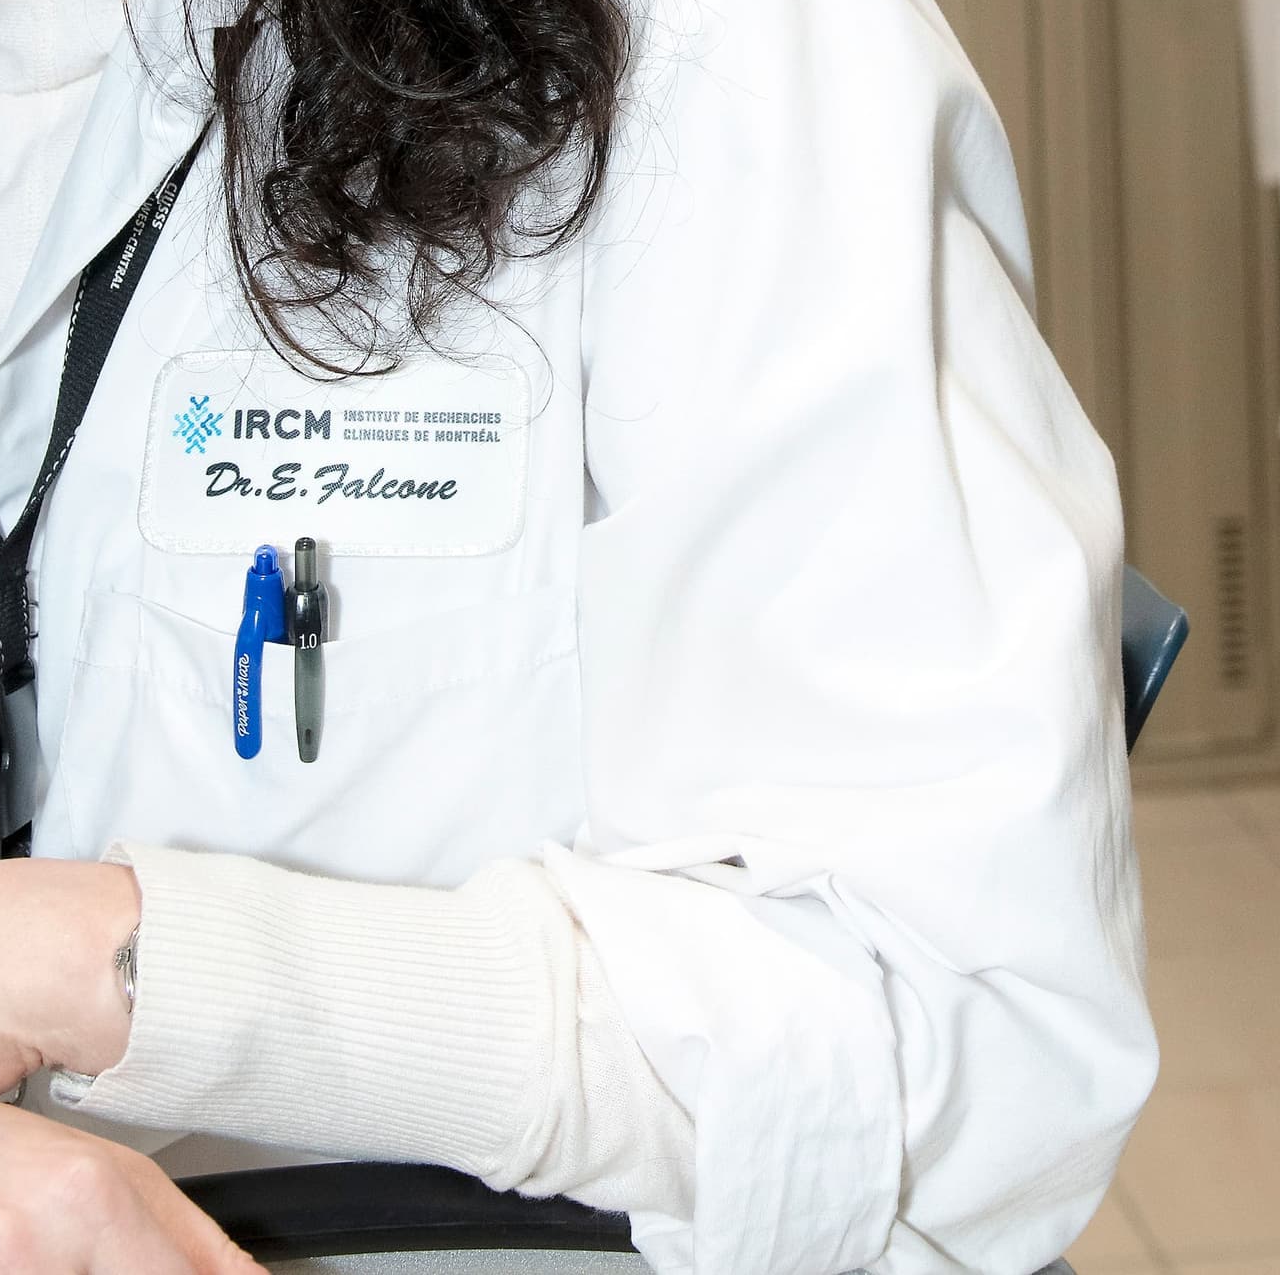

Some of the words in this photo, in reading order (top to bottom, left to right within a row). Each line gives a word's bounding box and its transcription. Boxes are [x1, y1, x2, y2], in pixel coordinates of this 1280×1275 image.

[234, 409, 331, 439] IRCM
[343, 409, 400, 423] INSTITUT
[404, 411, 420, 423] DE
[423, 411, 502, 424] RECHERCHES
[343, 428, 409, 442] CLINIQUES
[414, 429, 430, 442] DE
[434, 428, 501, 443] MONTRÉAL
[299, 633, 317, 649] 1.0
